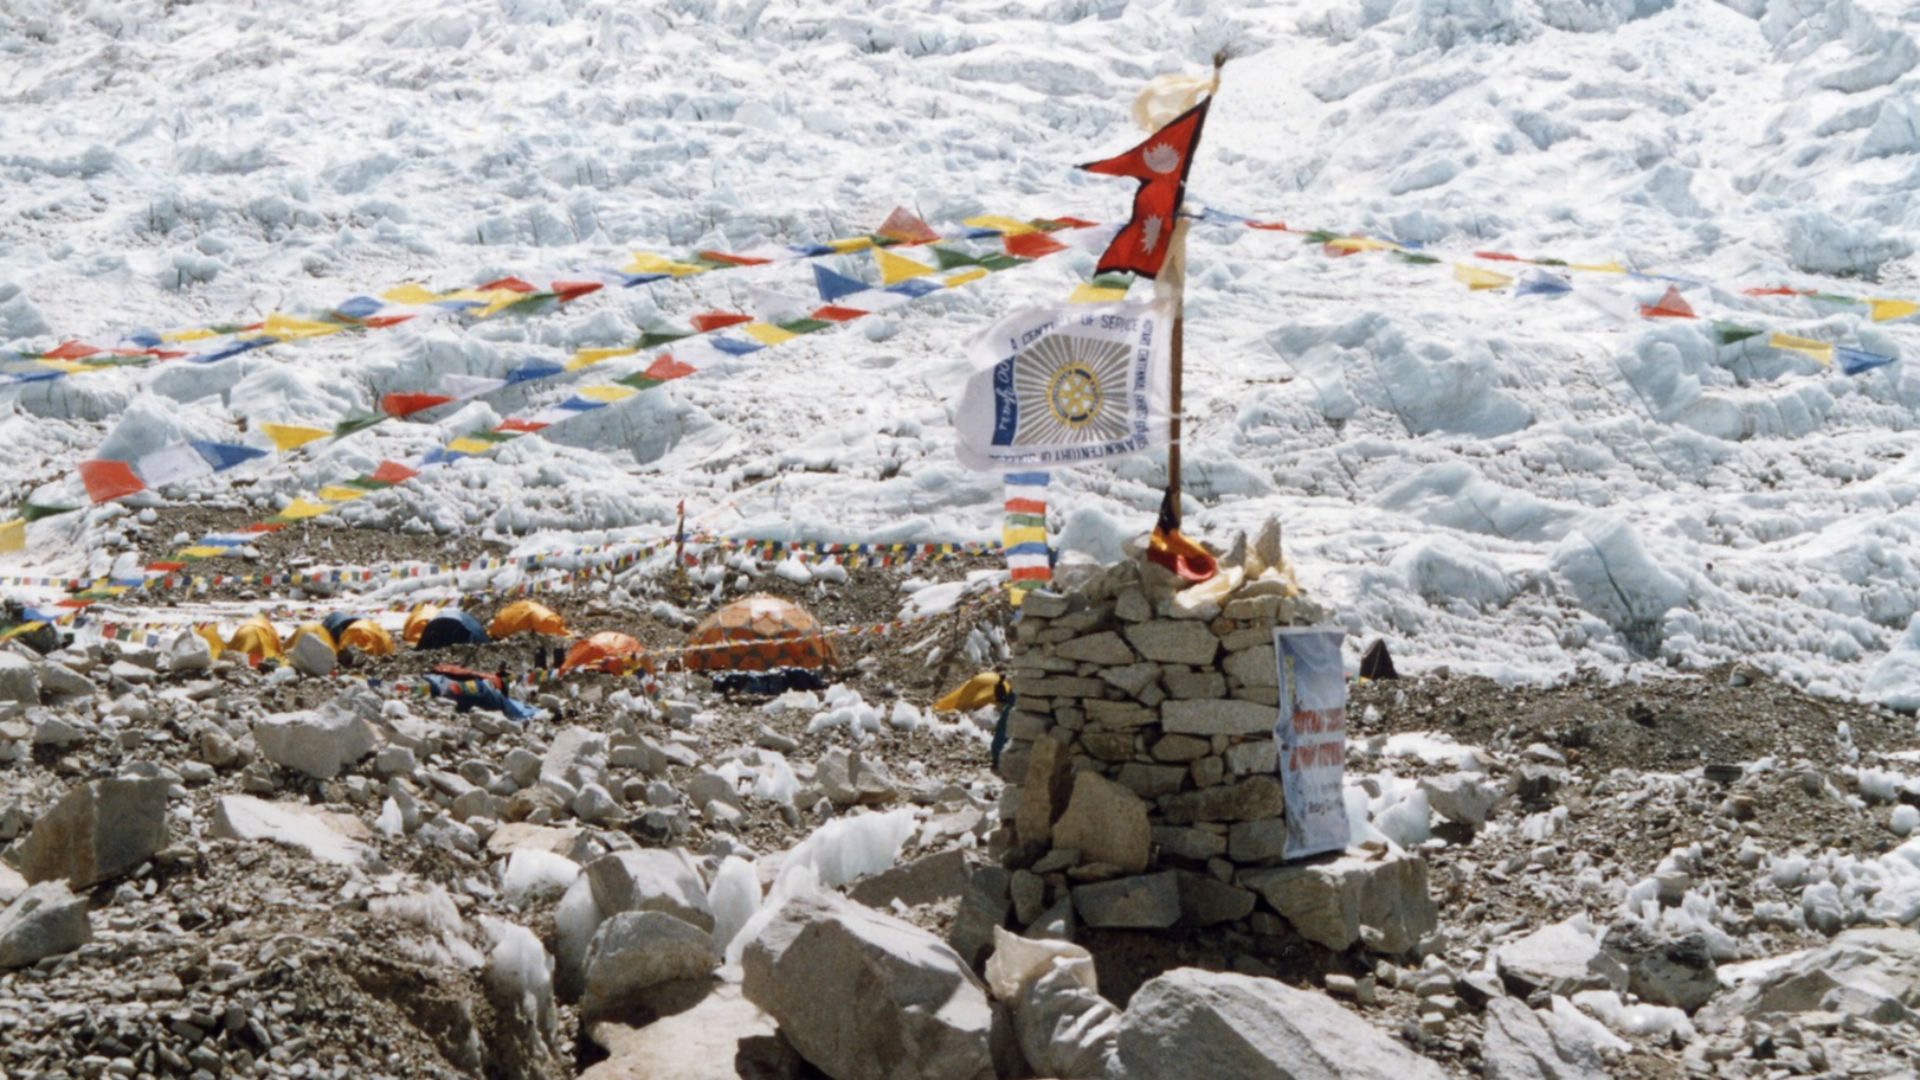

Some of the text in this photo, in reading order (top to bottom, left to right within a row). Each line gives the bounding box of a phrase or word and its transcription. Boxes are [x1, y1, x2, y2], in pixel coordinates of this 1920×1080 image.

[1010, 337, 1018, 350] A
[1100, 314, 1138, 333] SERVICE
[996, 359, 1011, 384] 00
[1104, 441, 1127, 454] NEW
